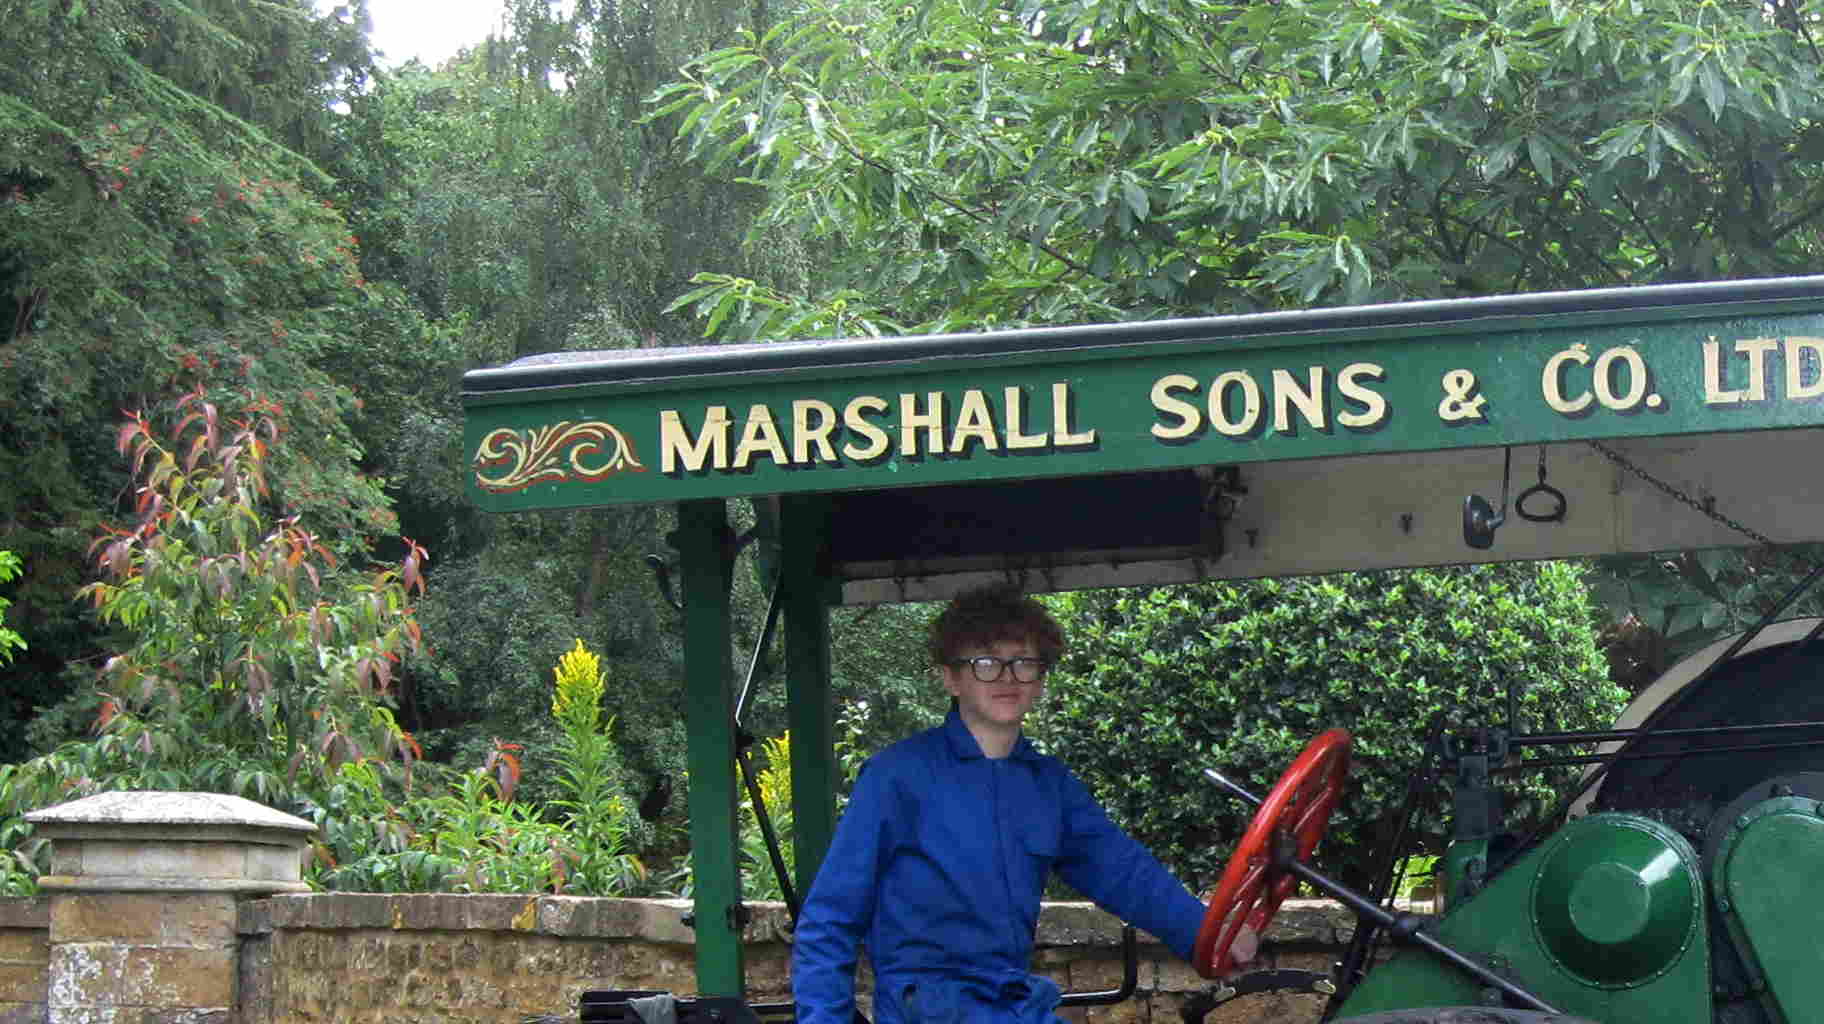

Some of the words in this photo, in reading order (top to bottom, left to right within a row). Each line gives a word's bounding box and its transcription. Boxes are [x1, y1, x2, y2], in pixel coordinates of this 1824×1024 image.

[659, 382, 1096, 473] MARSHALL
[1150, 362, 1387, 440] SONS
[1438, 369, 1486, 422] &
[1541, 345, 1663, 413] CO.
